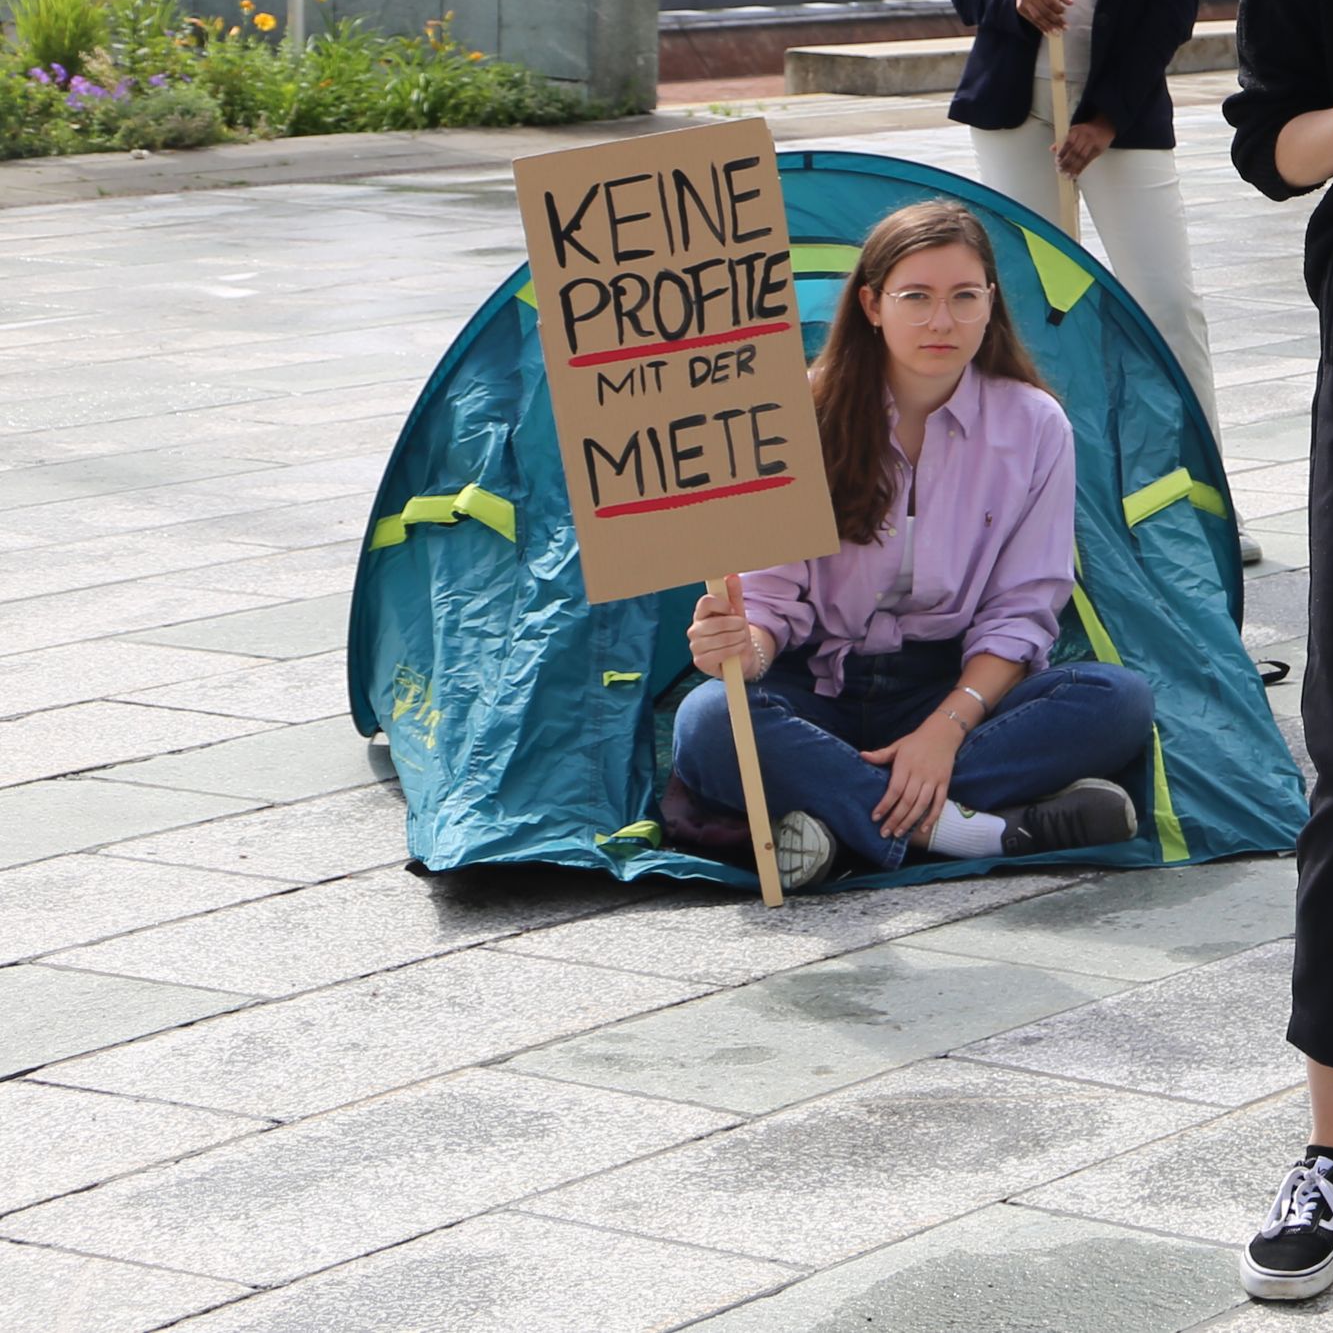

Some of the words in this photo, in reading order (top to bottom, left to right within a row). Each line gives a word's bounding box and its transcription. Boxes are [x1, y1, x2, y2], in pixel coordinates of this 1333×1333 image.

[545, 156, 773, 269] KEINE
[558, 250, 791, 355] PROFITE
[597, 360, 669, 406] MIT
[688, 344, 758, 389] DER
[582, 402, 790, 508] MIETE
